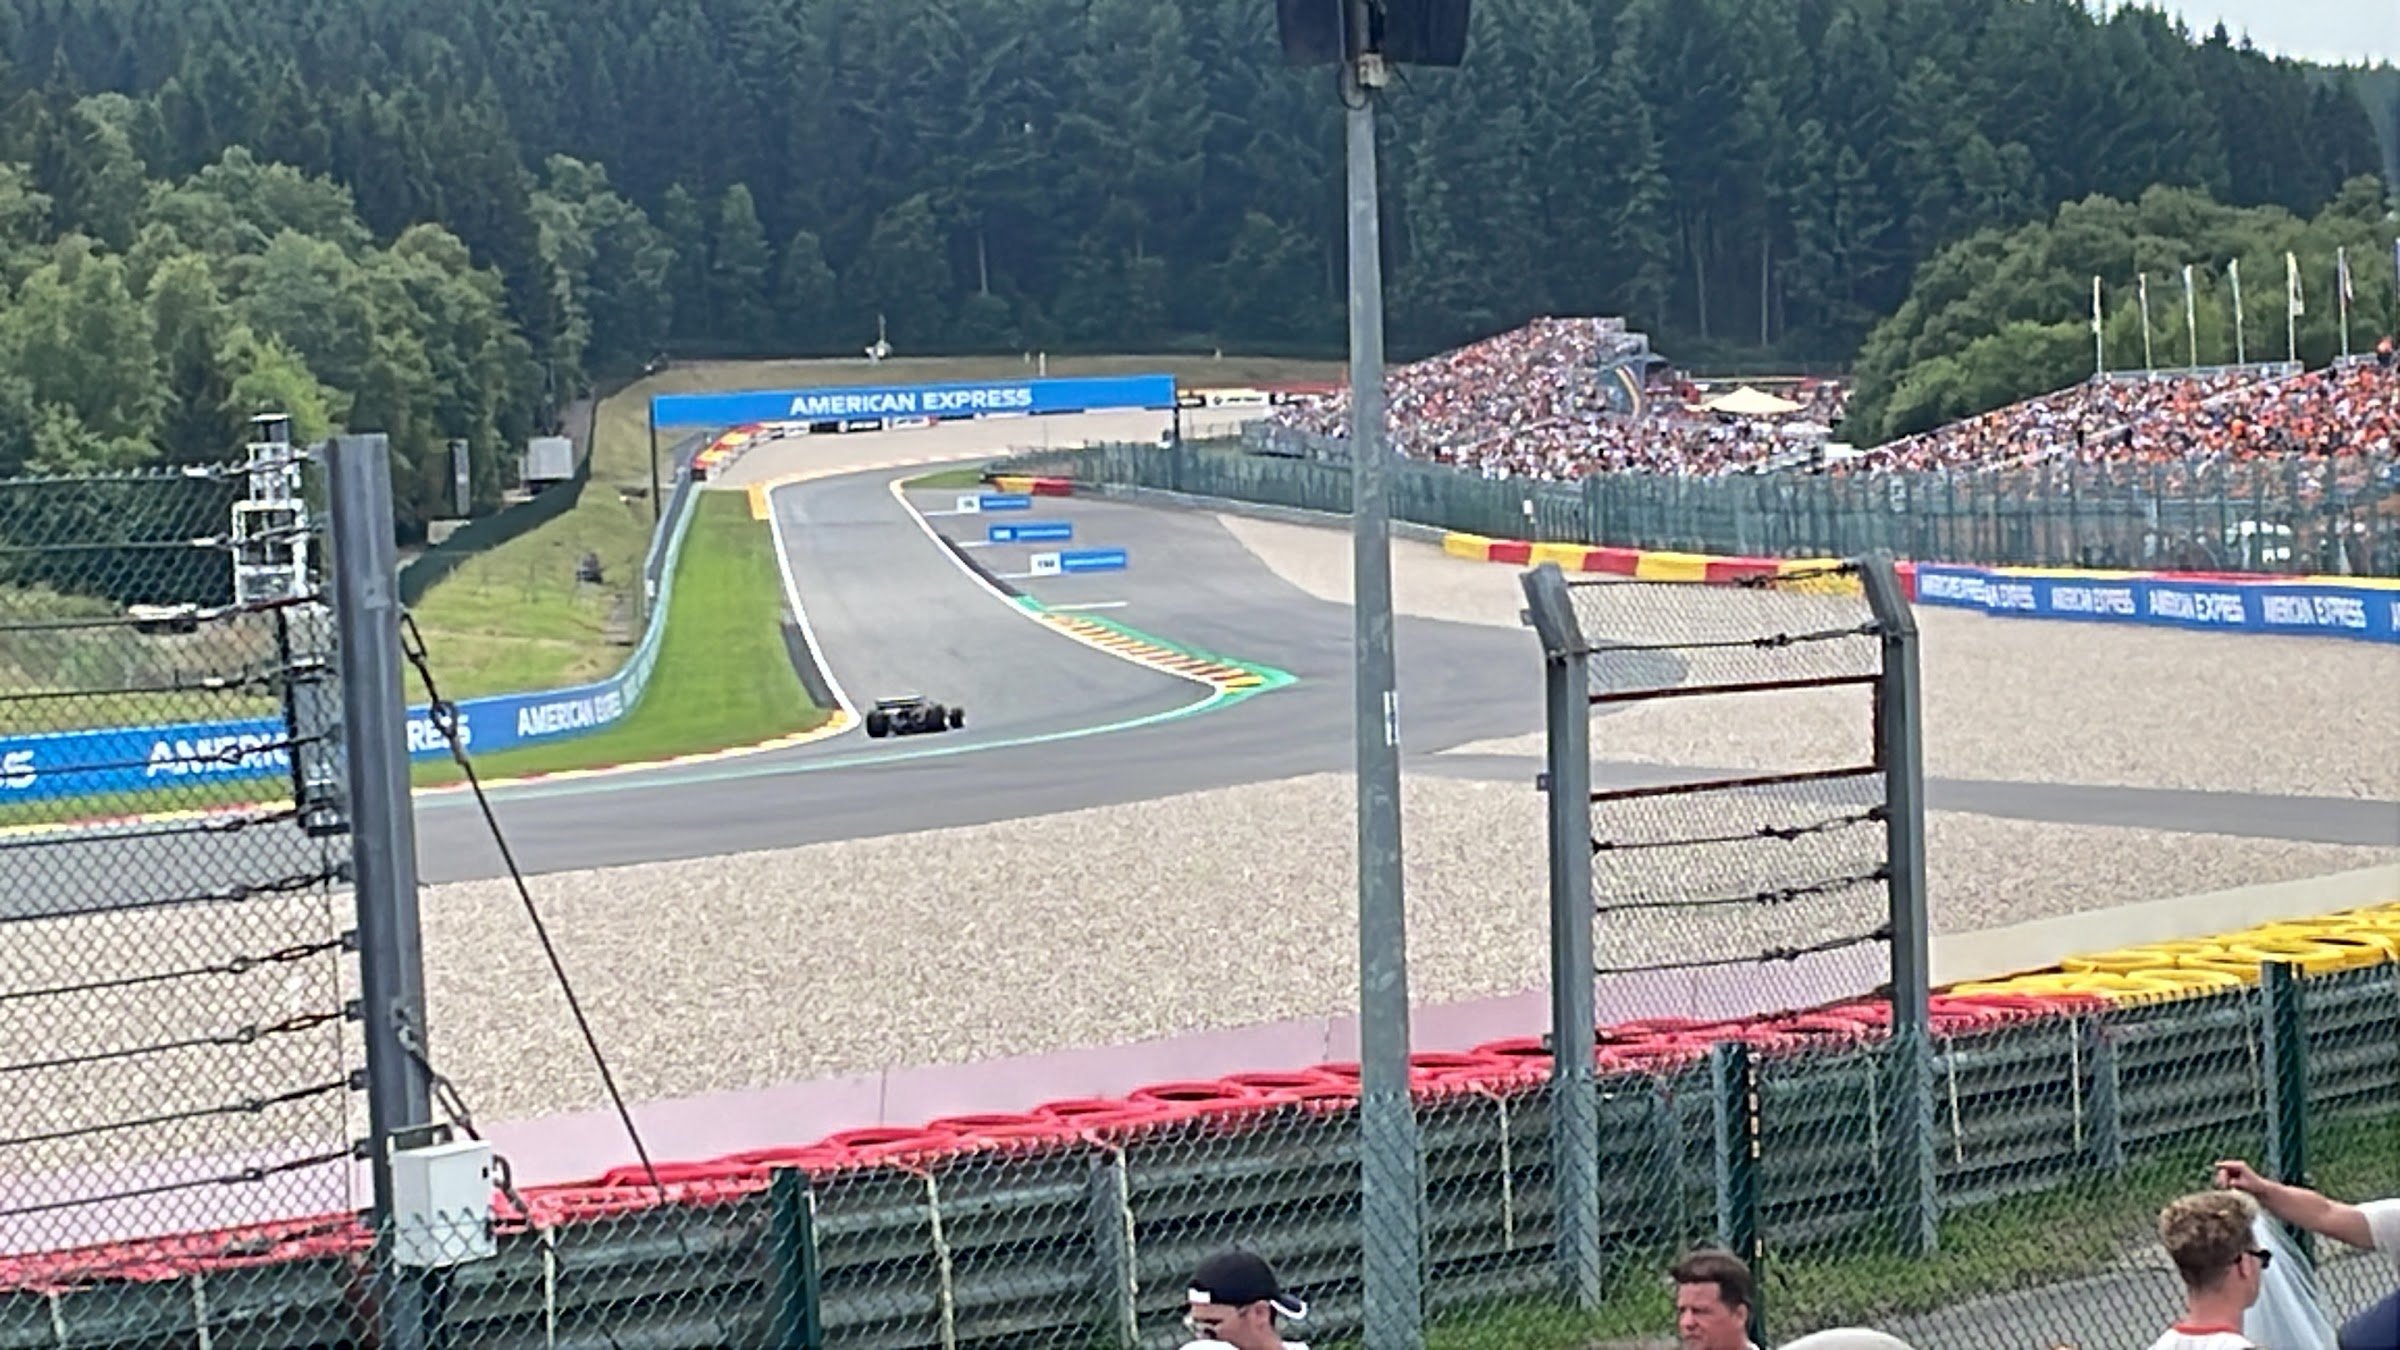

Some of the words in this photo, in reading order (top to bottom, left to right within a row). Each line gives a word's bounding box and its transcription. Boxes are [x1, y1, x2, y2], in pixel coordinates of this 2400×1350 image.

[789, 393, 916, 416] AMERICAN
[922, 388, 1032, 409] EXPRESS
[517, 698, 592, 737] AMERICAN
